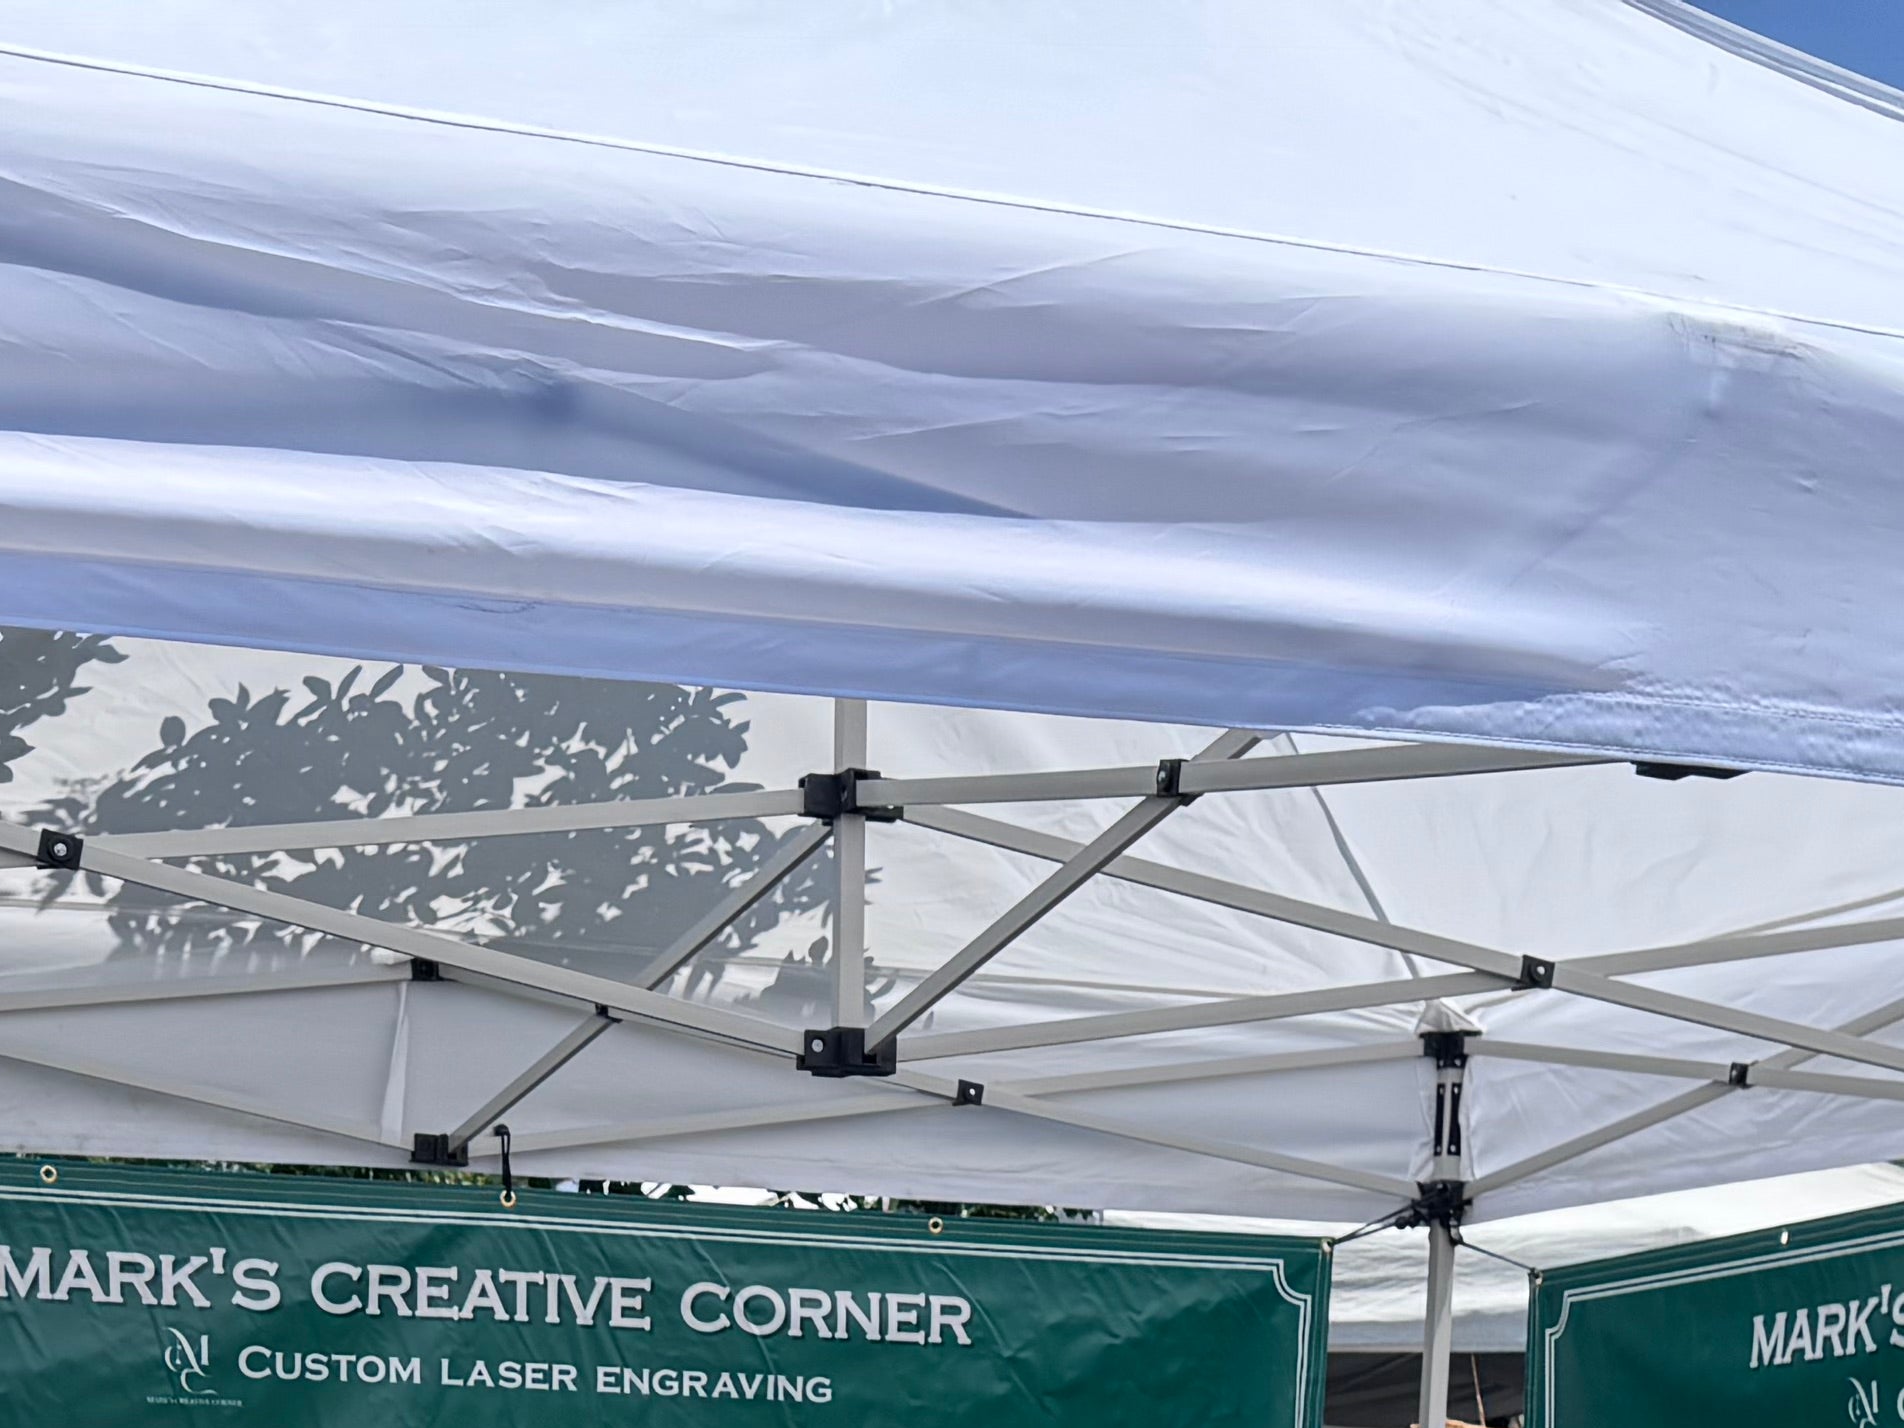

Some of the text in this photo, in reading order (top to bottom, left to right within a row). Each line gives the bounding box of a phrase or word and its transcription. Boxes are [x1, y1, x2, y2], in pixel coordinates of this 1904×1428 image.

[310, 1261, 652, 1332] CREATIVE
[680, 1281, 972, 1346] CORNER
[440, 1358, 578, 1392] LASER
[596, 1365, 833, 1404] ENGRAVING
